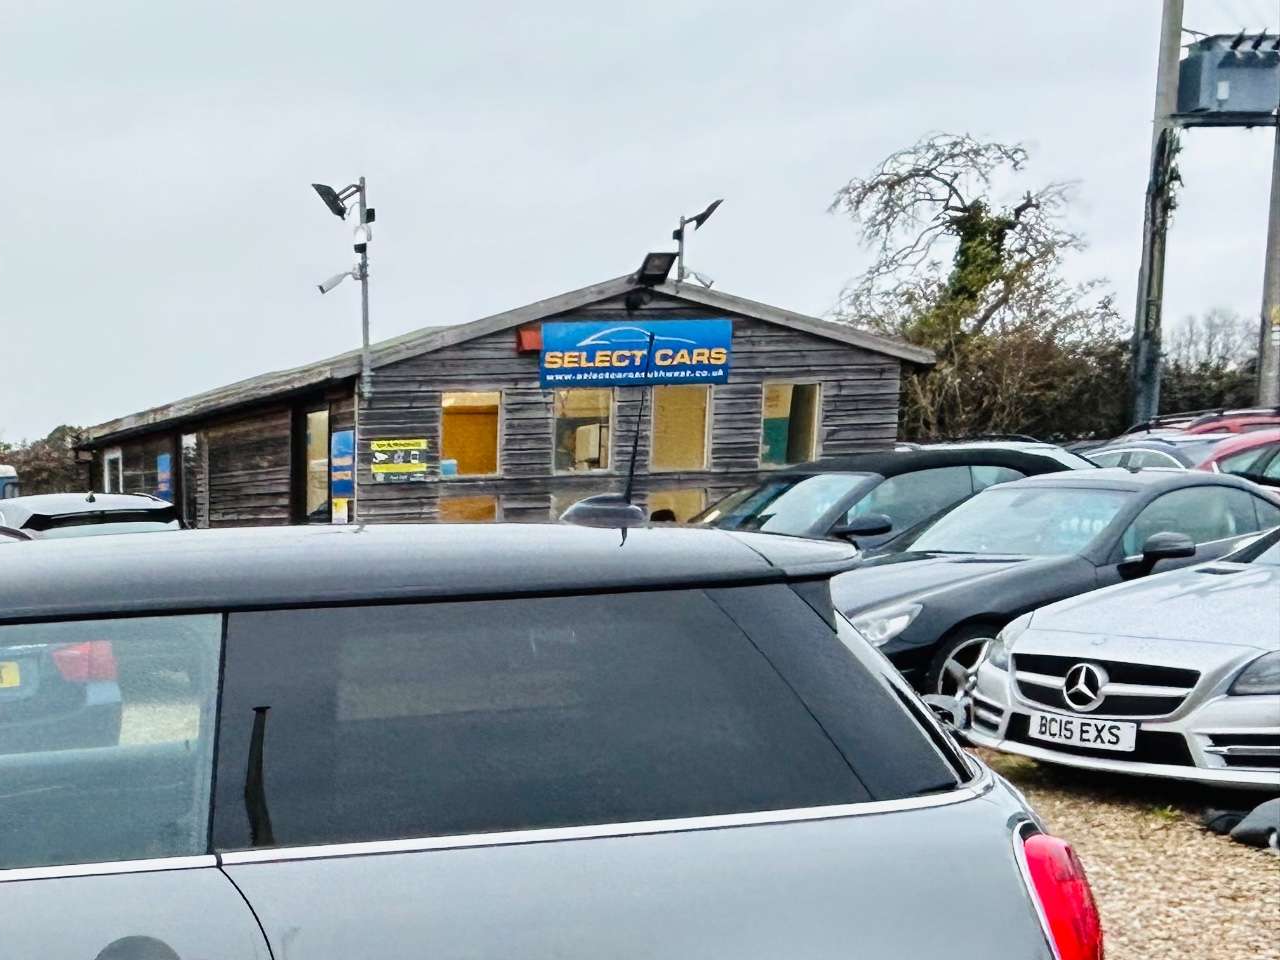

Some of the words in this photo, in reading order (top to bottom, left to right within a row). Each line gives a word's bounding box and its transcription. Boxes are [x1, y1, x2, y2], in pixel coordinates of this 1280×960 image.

[544, 351, 647, 368] SELECT
[655, 348, 727, 366] CARS
[1039, 716, 1074, 739] BC15
[1080, 722, 1121, 745] EXS
